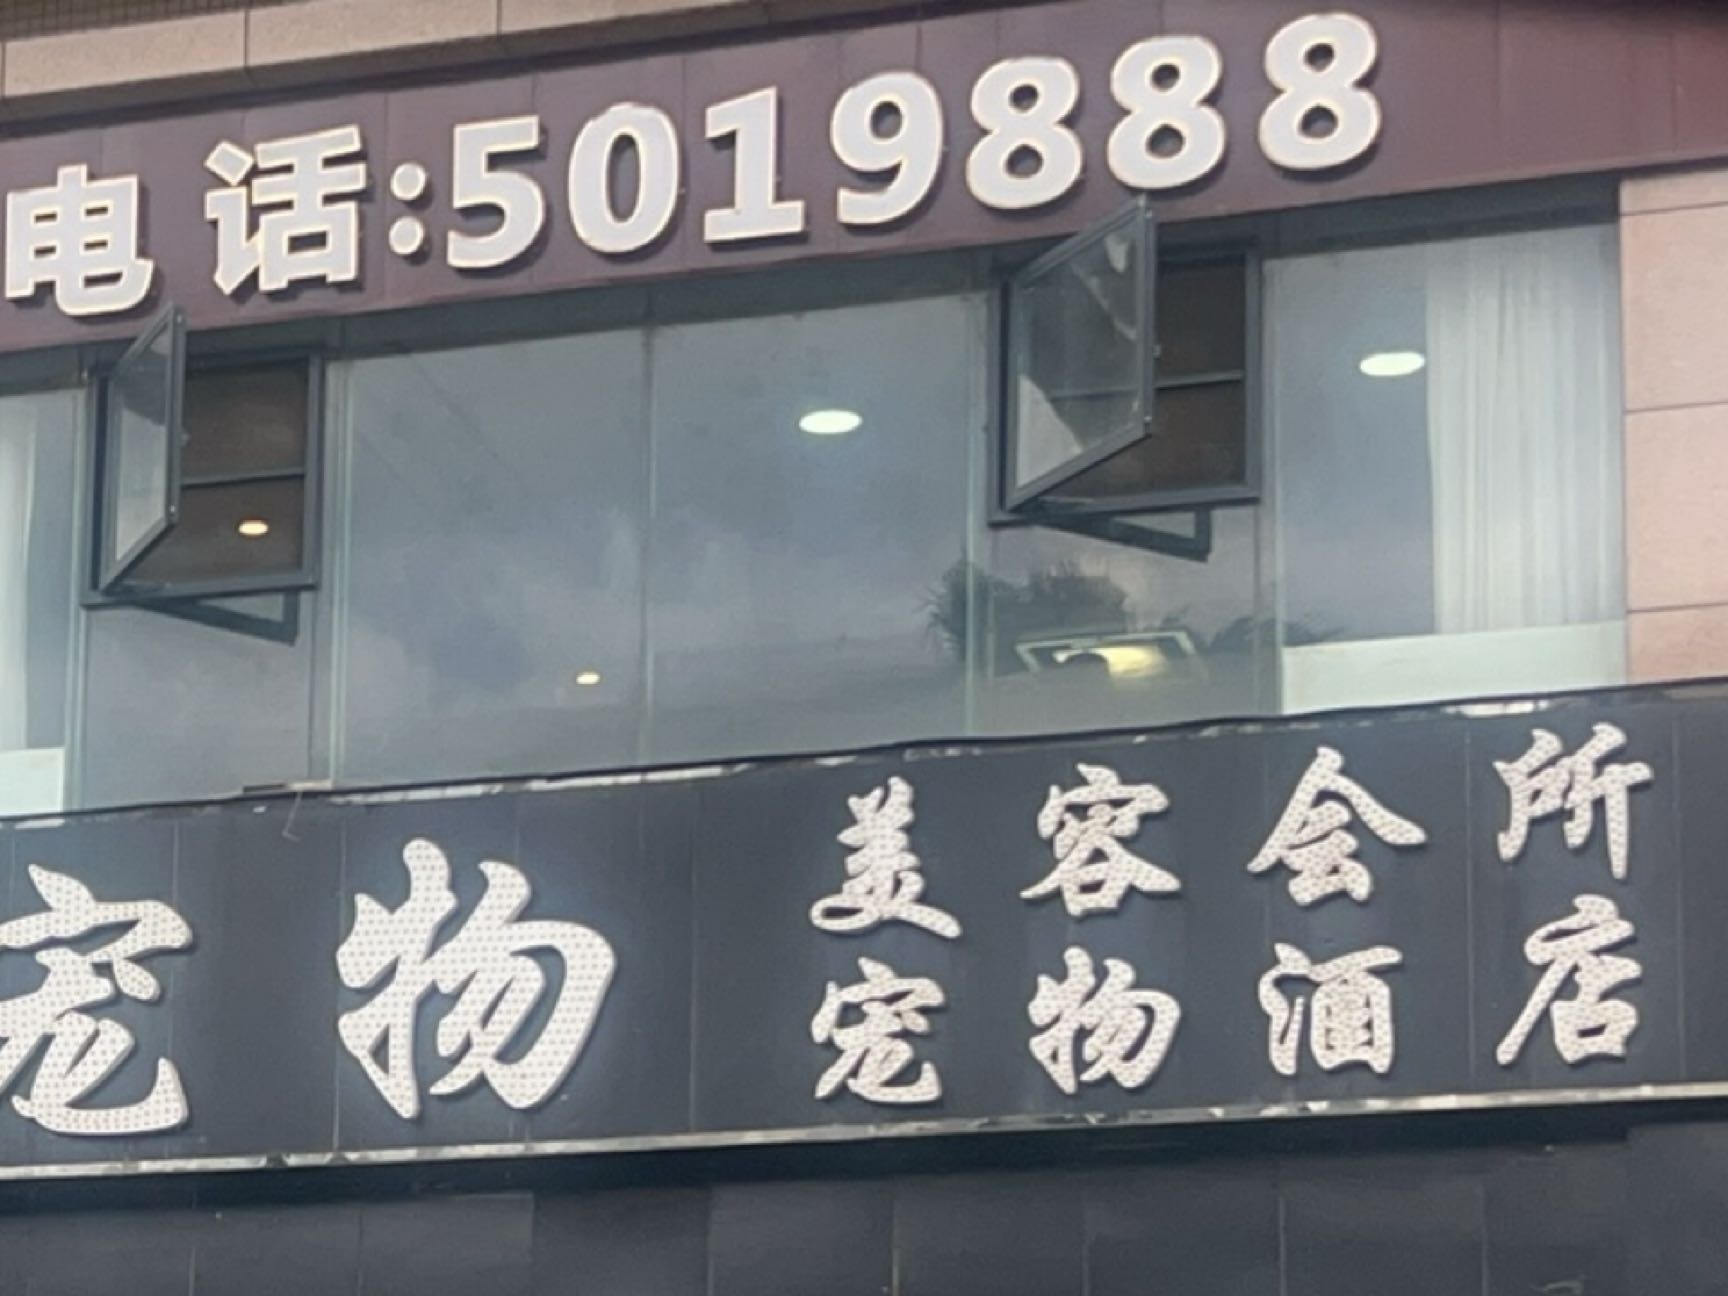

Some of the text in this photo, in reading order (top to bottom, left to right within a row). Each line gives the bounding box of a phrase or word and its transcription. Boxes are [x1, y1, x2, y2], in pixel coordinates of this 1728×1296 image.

[4, 12, 1382, 316] 电话:5019888
[809, 722, 1654, 938] 美容会所
[809, 893, 1643, 1104] 宠物酒店
